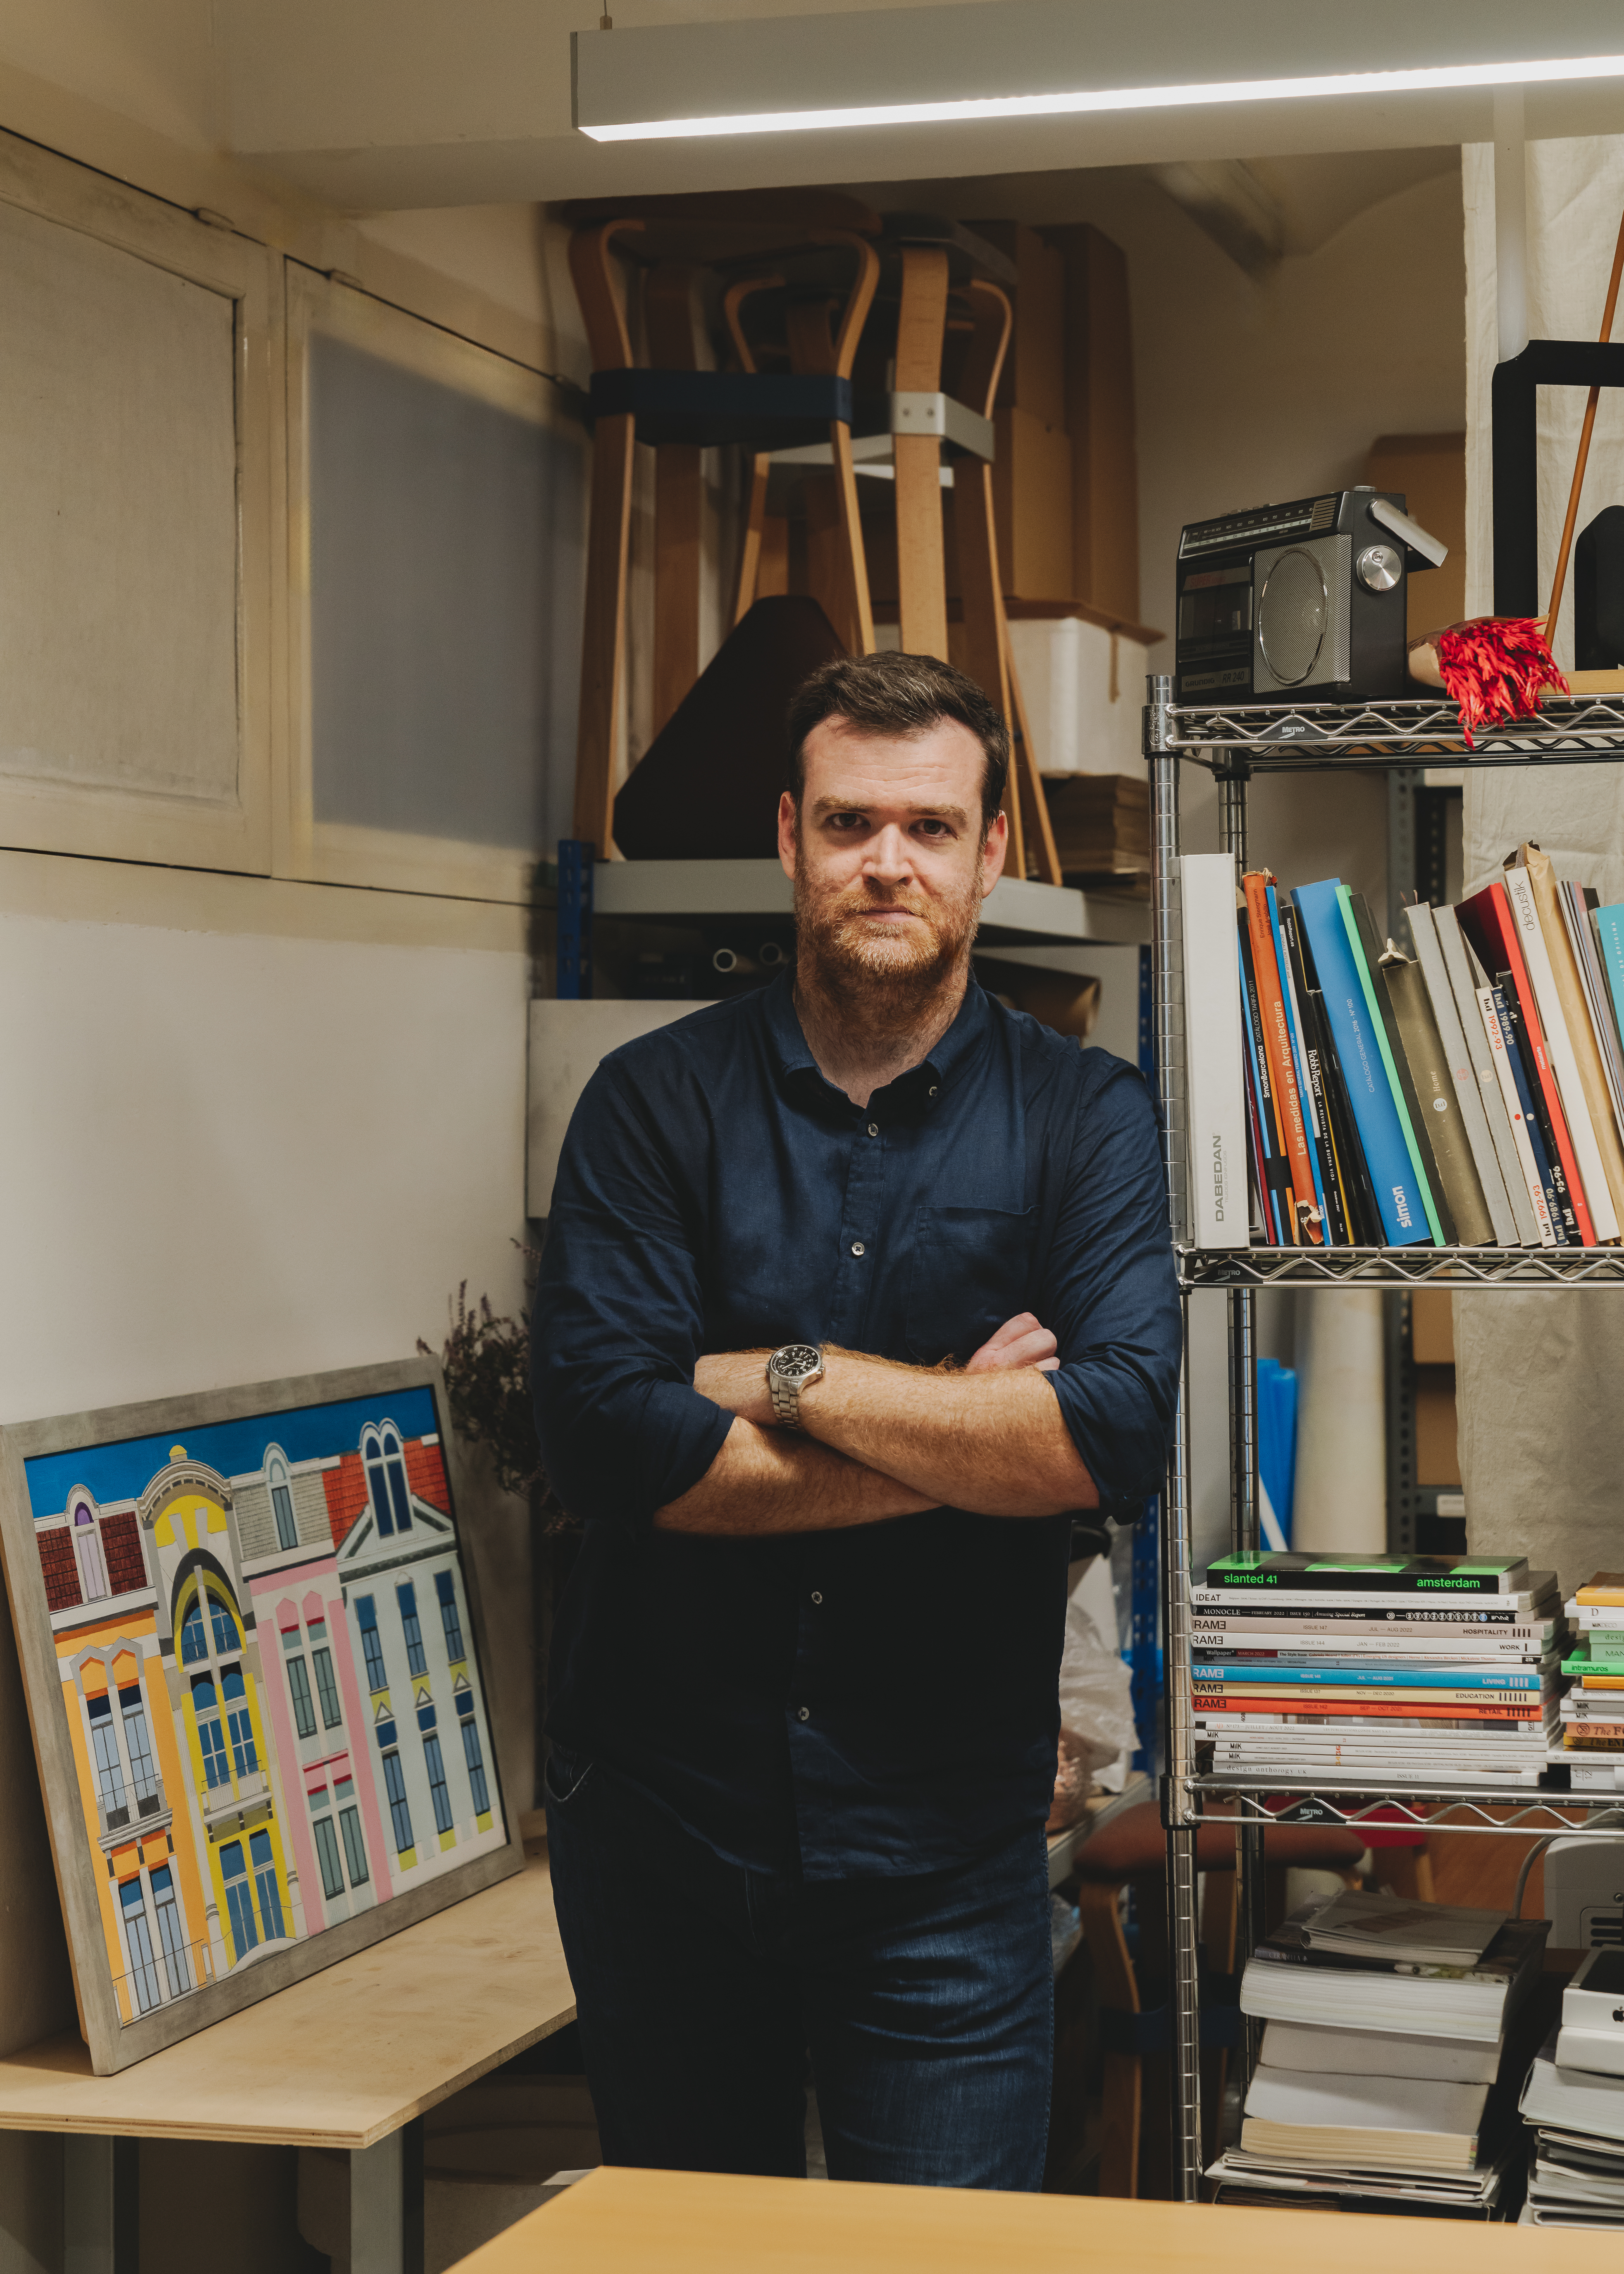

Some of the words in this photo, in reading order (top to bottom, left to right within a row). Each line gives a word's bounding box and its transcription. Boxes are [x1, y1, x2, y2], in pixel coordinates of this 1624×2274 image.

[1185, 678, 1215, 687] GRUNDIG
[1222, 673, 1231, 683] RR
[1233, 671, 1245, 682] 240
[1514, 881, 1535, 930] decustik
[1611, 922, 1622, 955] OFICINA
[1253, 1013, 1262, 1042] CATÁLOGO
[1274, 1001, 1292, 1067] Arquitectura
[1488, 1015, 1502, 1050] 1992-93
[1499, 1012, 1514, 1045] 1989-90
[1355, 1032, 1366, 1060] GENERAL
[1286, 1071, 1294, 1084] en
[1362, 1061, 1375, 1092] CATÁLOGO
[1431, 1071, 1440, 1092] Home
[1289, 1087, 1303, 1133] medidas
[1297, 1136, 1307, 1155] Las
[1553, 1166, 1565, 1193] 95-96
[1392, 1186, 1412, 1228] simon
[1533, 1185, 1547, 1220] 1992-93
[1546, 1188, 1560, 1222] 1989-90
[1224, 1574, 1264, 1584] slanted
[1266, 1574, 1277, 1584] 41
[1417, 1578, 1480, 1588] amsterdam
[1594, 1726, 1611, 1736] The
[1614, 1726, 1624, 1736] F
[1227, 1765, 1252, 1774] design
[1256, 1766, 1294, 1775] anthology
